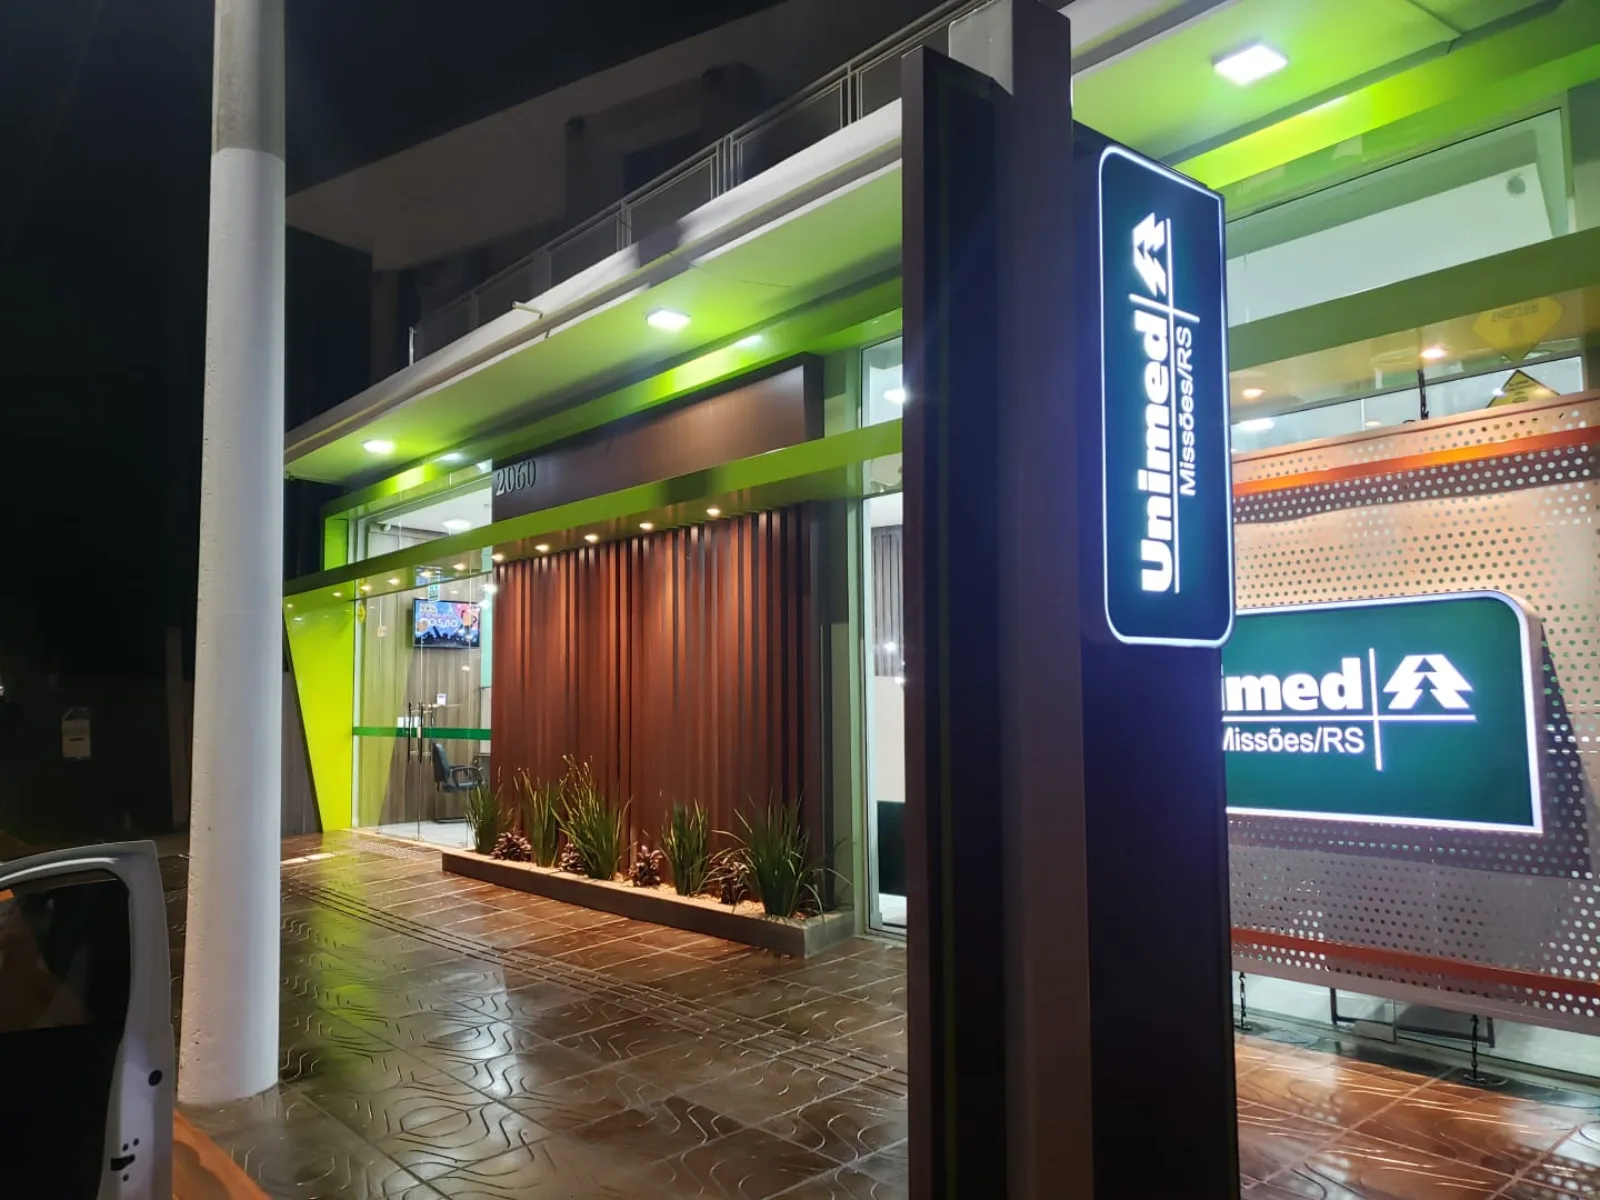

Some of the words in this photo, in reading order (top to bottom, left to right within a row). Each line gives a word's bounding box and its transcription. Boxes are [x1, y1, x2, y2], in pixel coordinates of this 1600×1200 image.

[1134, 309, 1173, 593] Unimed
[1176, 326, 1196, 496] Missões/RS
[495, 459, 536, 497] 2060
[1221, 657, 1363, 711] med
